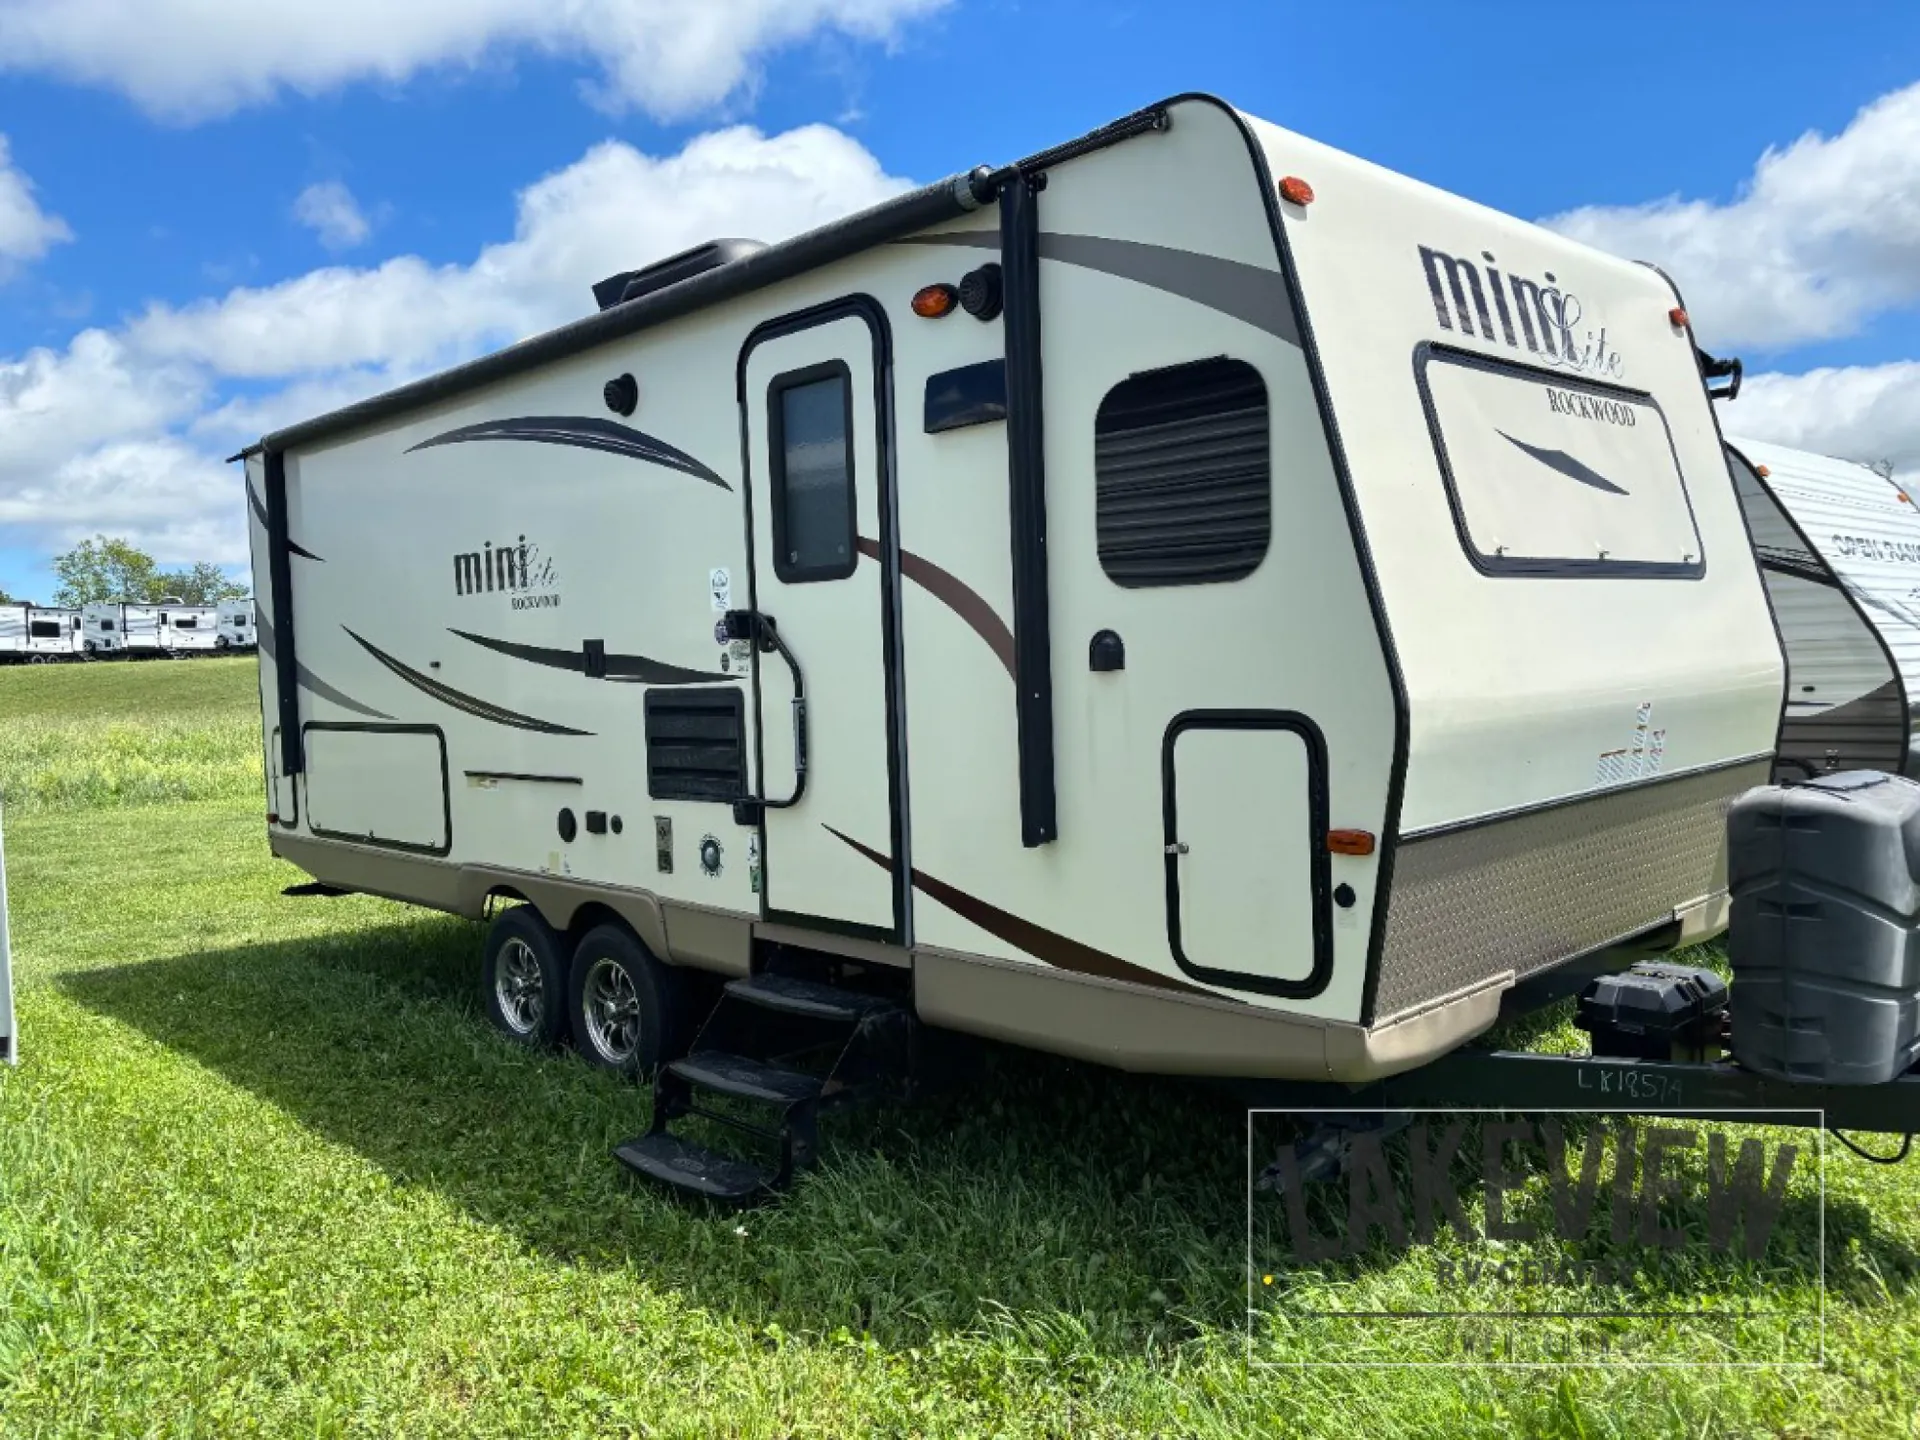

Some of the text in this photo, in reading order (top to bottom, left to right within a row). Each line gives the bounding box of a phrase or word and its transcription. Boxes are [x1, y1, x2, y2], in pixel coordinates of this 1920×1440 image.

[1416, 243, 1579, 362] mini
[1539, 287, 1626, 380] Lite
[1546, 387, 1637, 427] ROCKWOOD
[453, 534, 528, 596] mini
[1831, 534, 1884, 560] OPEN
[511, 594, 562, 610] ROCKWOOD
